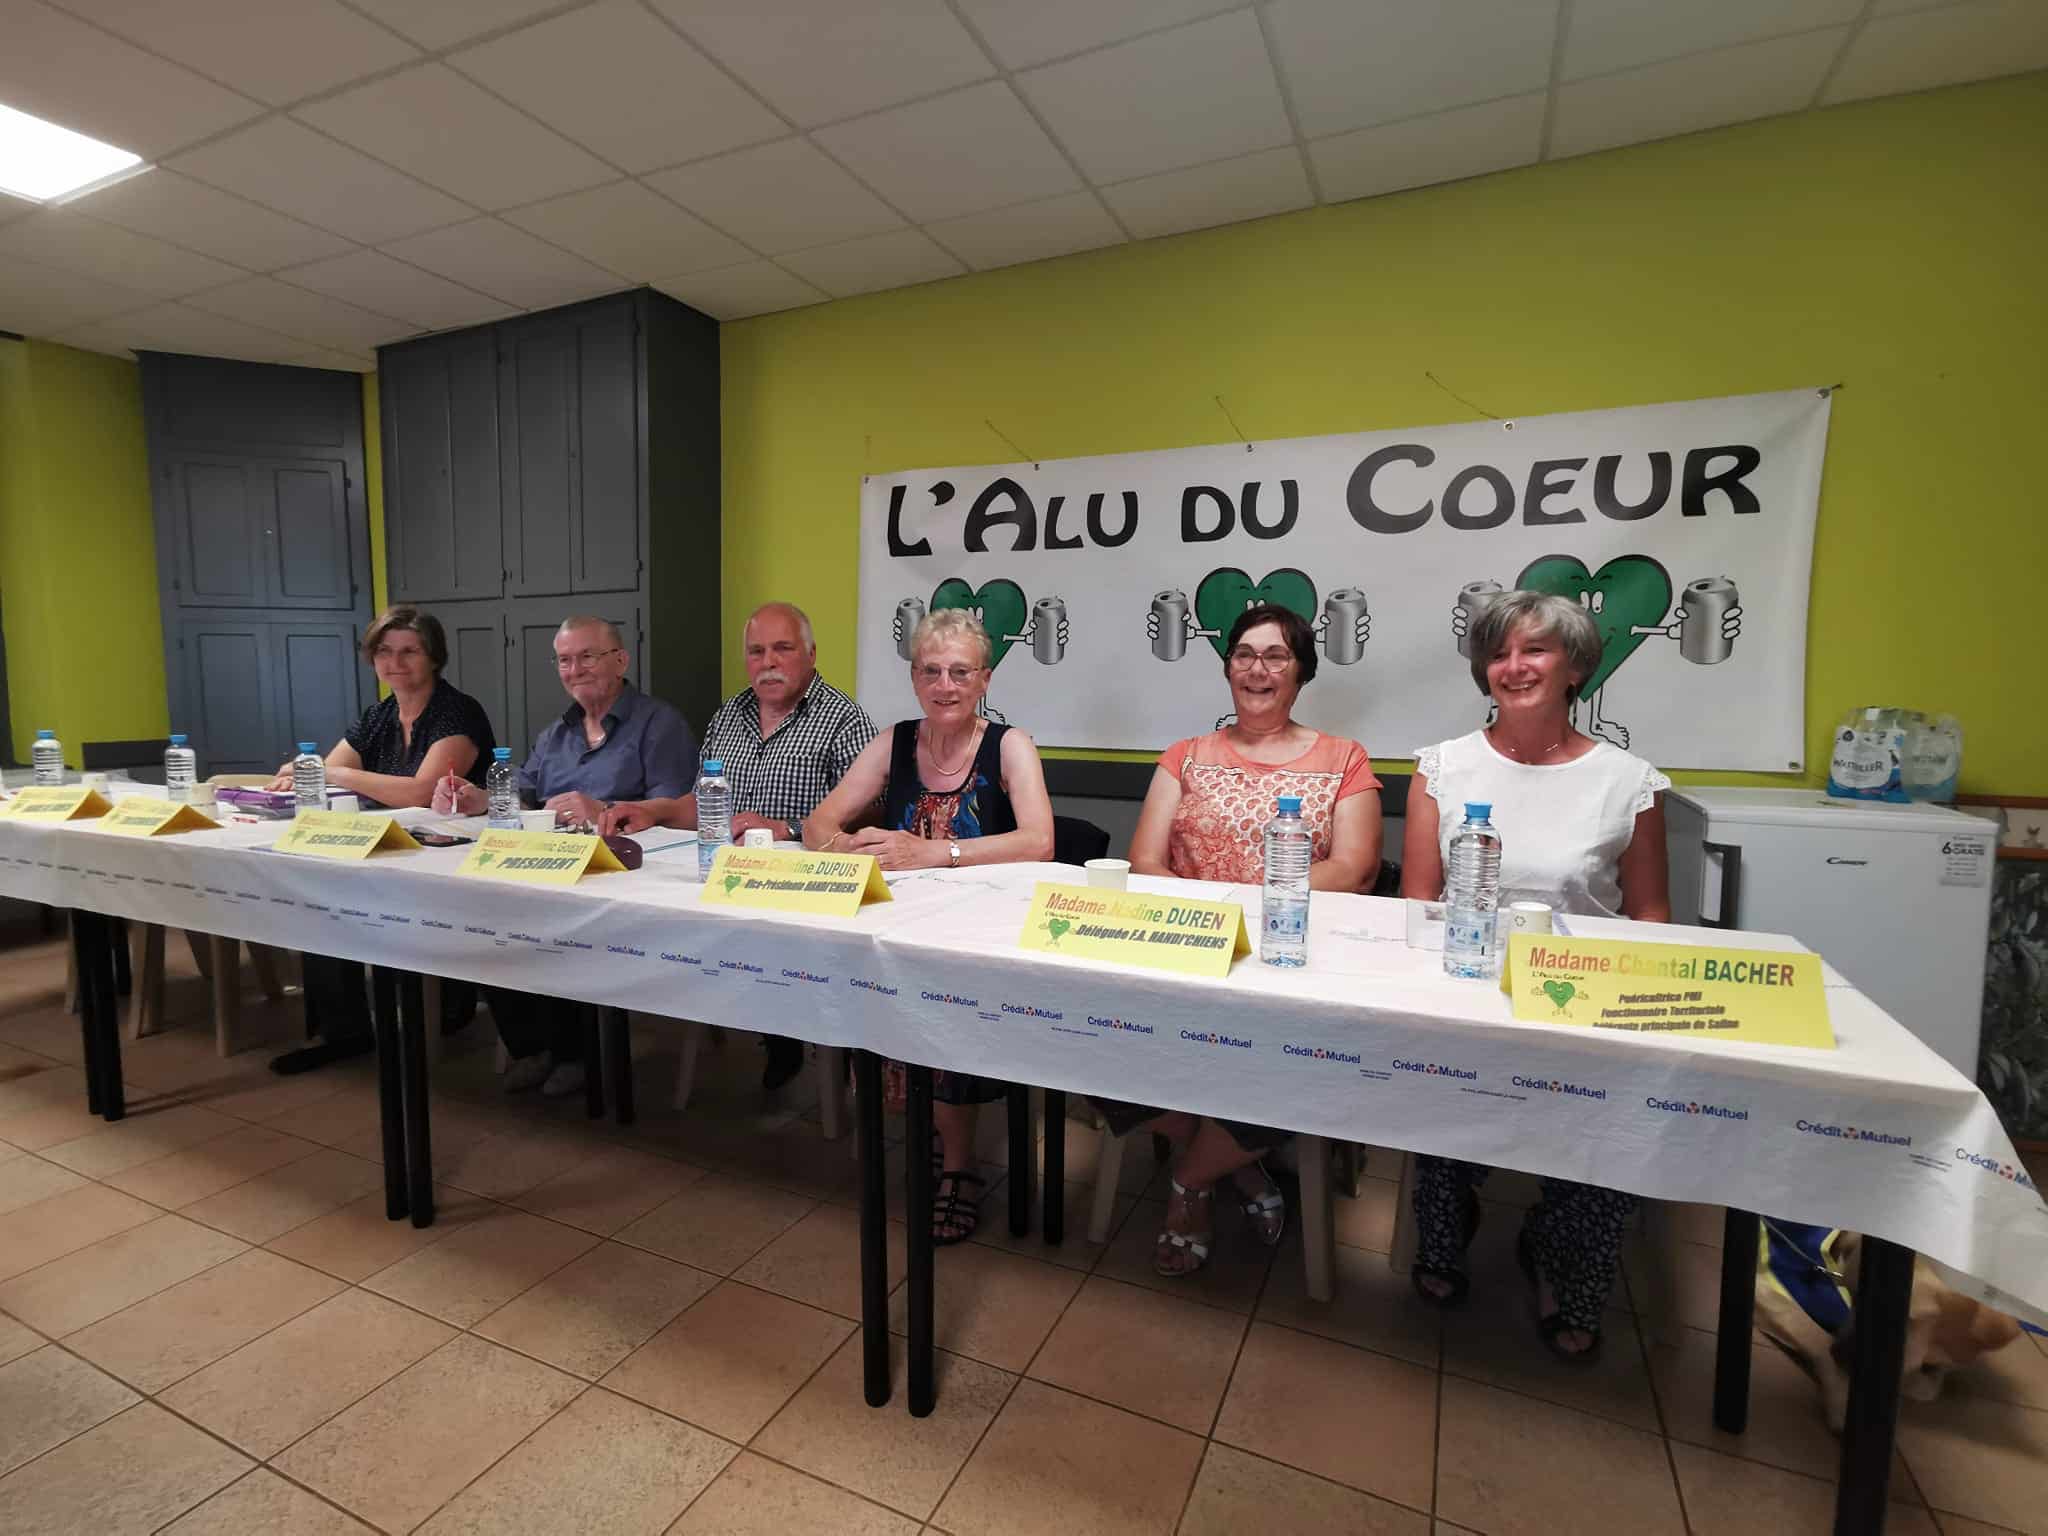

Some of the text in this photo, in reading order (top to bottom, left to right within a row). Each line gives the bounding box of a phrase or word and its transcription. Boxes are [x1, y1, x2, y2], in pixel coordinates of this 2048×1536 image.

[1180, 479, 1299, 544] DU
[1346, 443, 1762, 535] COEUR
[815, 860, 860, 878] DUPUIS
[1045, 891, 1227, 931] Madame Ndine DUREN
[1075, 923, 1129, 941] Déléguée
[1529, 946, 1795, 987] Madame Chntal BACHER
[1001, 1003, 1063, 1020] Crédit Mutuel
[1087, 1015, 1153, 1034] Crédit Mutuel
[1180, 1029, 1252, 1048] Crédit Mutuel
[1282, 1044, 1361, 1064] Crédit Mutuel
[1392, 1059, 1477, 1081] Crédit Mutuel
[1511, 1075, 1607, 1100] Crédit Mutuel
[1646, 1097, 1749, 1121] Crédit Mutuel
[1795, 1119, 1912, 1147] Crédit Mutuel
[1955, 1147, 1999, 1173] Crédit
